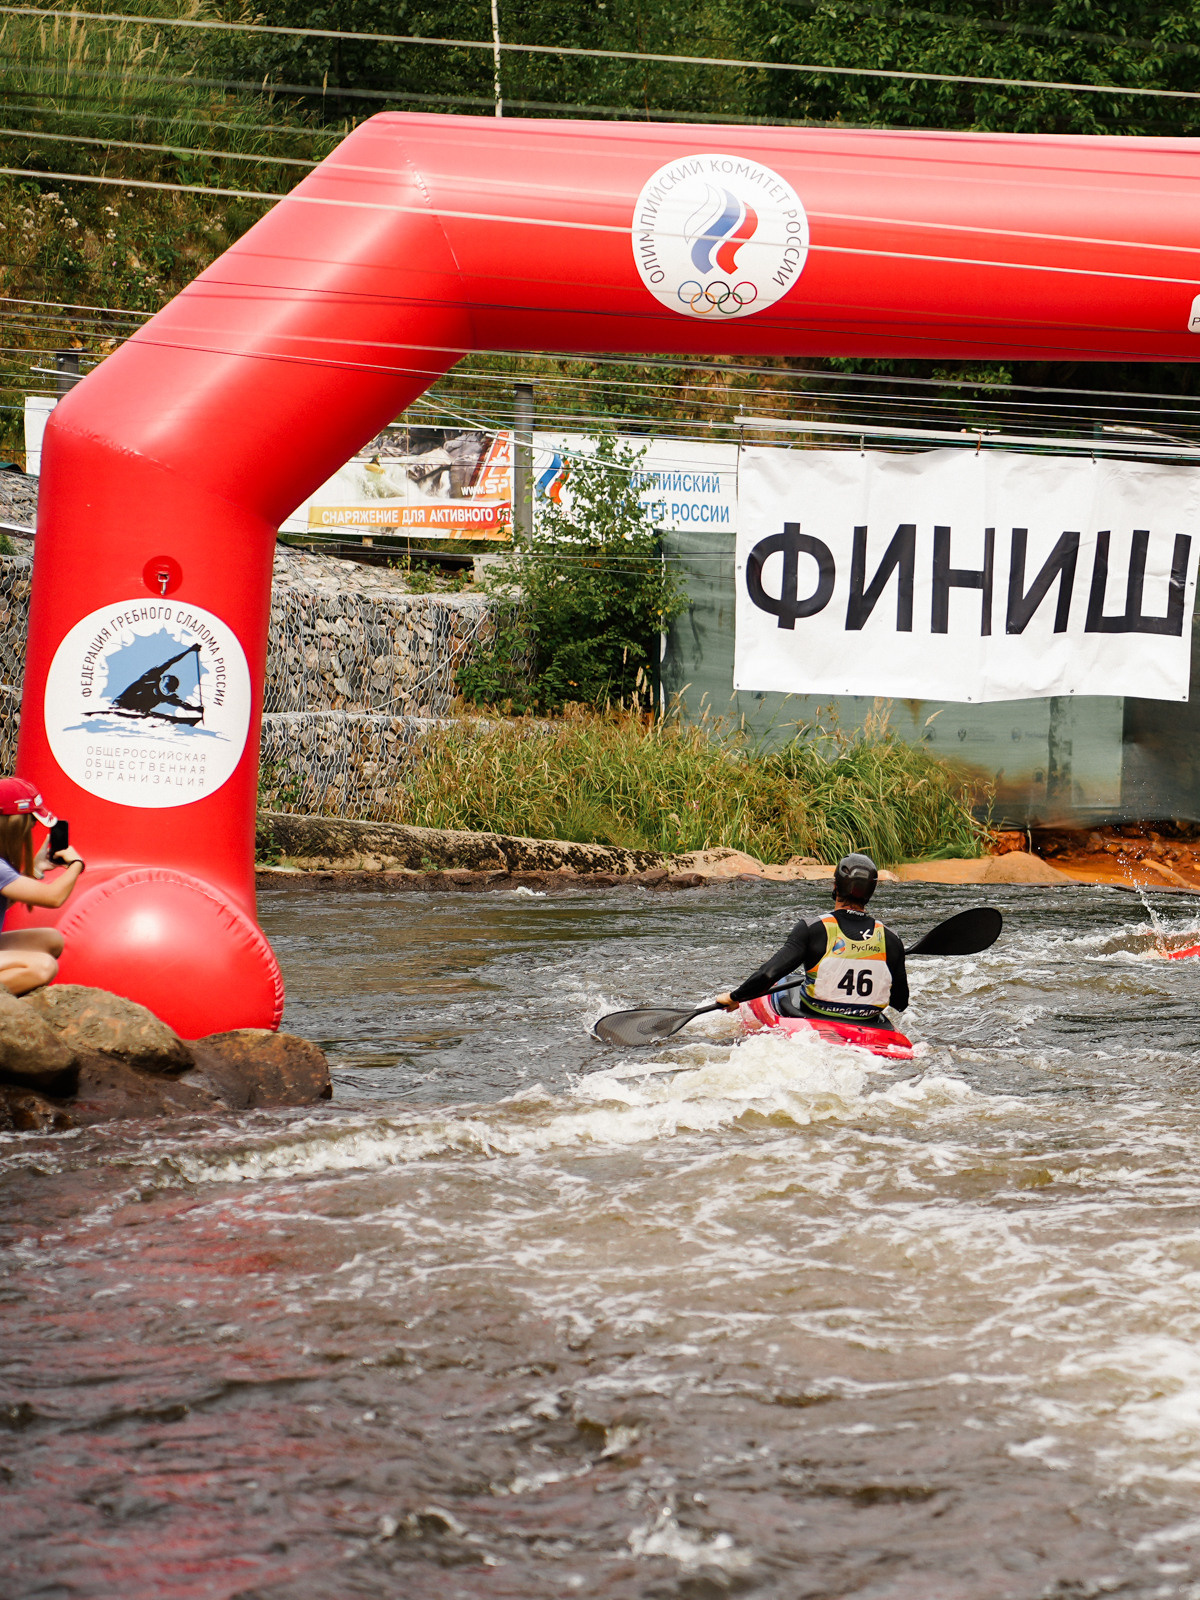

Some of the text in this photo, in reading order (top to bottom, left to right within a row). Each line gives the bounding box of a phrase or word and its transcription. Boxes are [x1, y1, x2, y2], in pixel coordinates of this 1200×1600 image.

[639, 158, 802, 288] ОЛИМПИЙСКИЙ КОМИТЕТ РОССИИ
[321, 507, 399, 524] СНАРЯЖЕНИЕ
[402, 508, 426, 525] ДЛЯ
[429, 507, 494, 524] АКТИВНОГО
[671, 502, 730, 523] РОССИИ
[745, 522, 1192, 638] ФИНИШ
[81, 606, 227, 707] ФЕДЕРАЦИЯ ГРЕБНОГО СЛАЛОМА РОССИИ
[86, 745, 207, 763] ОБЩЕРОССИЙСКАЯ
[85, 758, 206, 773] ОБЩЕСТВЕННАЯ
[84, 770, 205, 787] ОРГАНИЗАЦИЯ
[837, 968, 873, 997] 46
